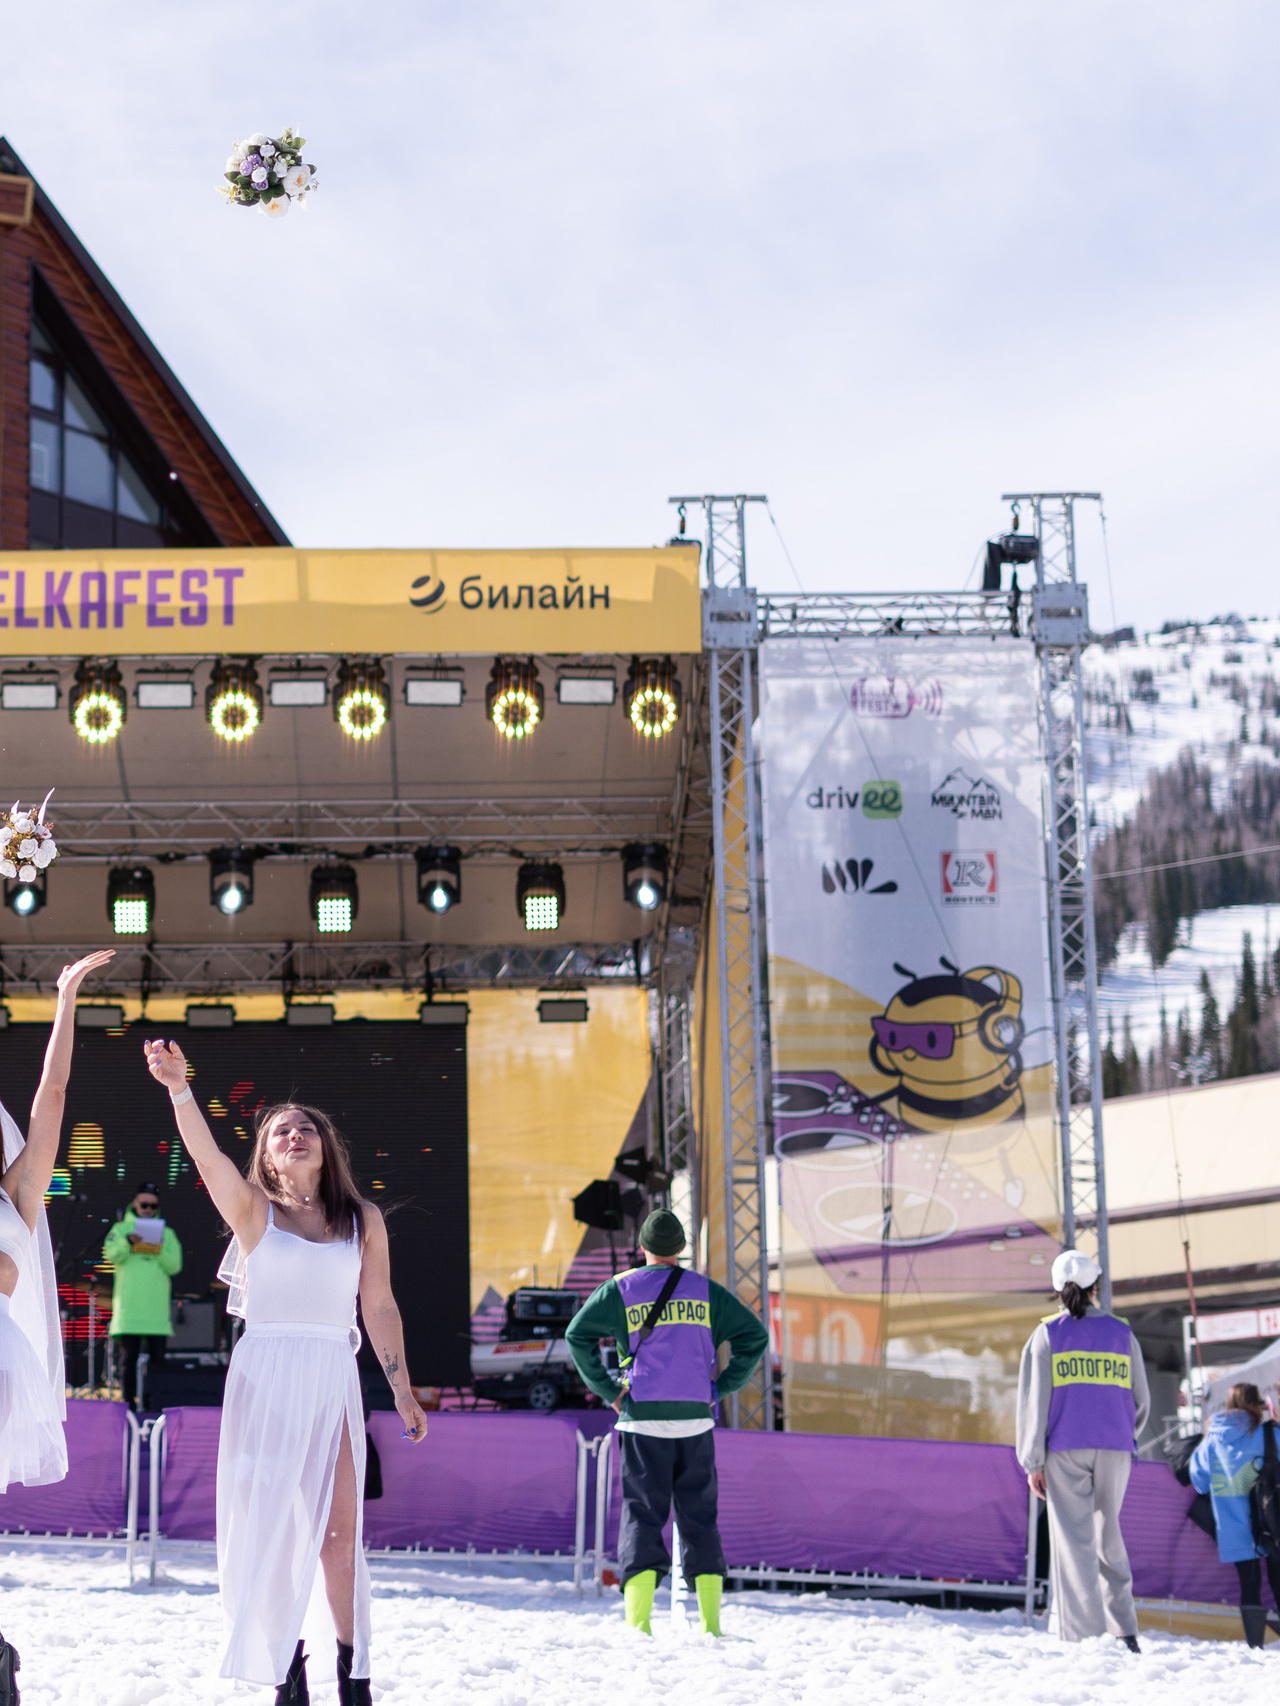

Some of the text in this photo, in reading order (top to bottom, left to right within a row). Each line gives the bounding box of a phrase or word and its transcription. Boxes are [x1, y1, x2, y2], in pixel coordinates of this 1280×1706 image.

[459, 575, 610, 610] билайн
[806, 786, 902, 812] drivee
[628, 1301, 706, 1326] ФООГРАФ
[1056, 1357, 1129, 1379] ФОТОГРАФ
